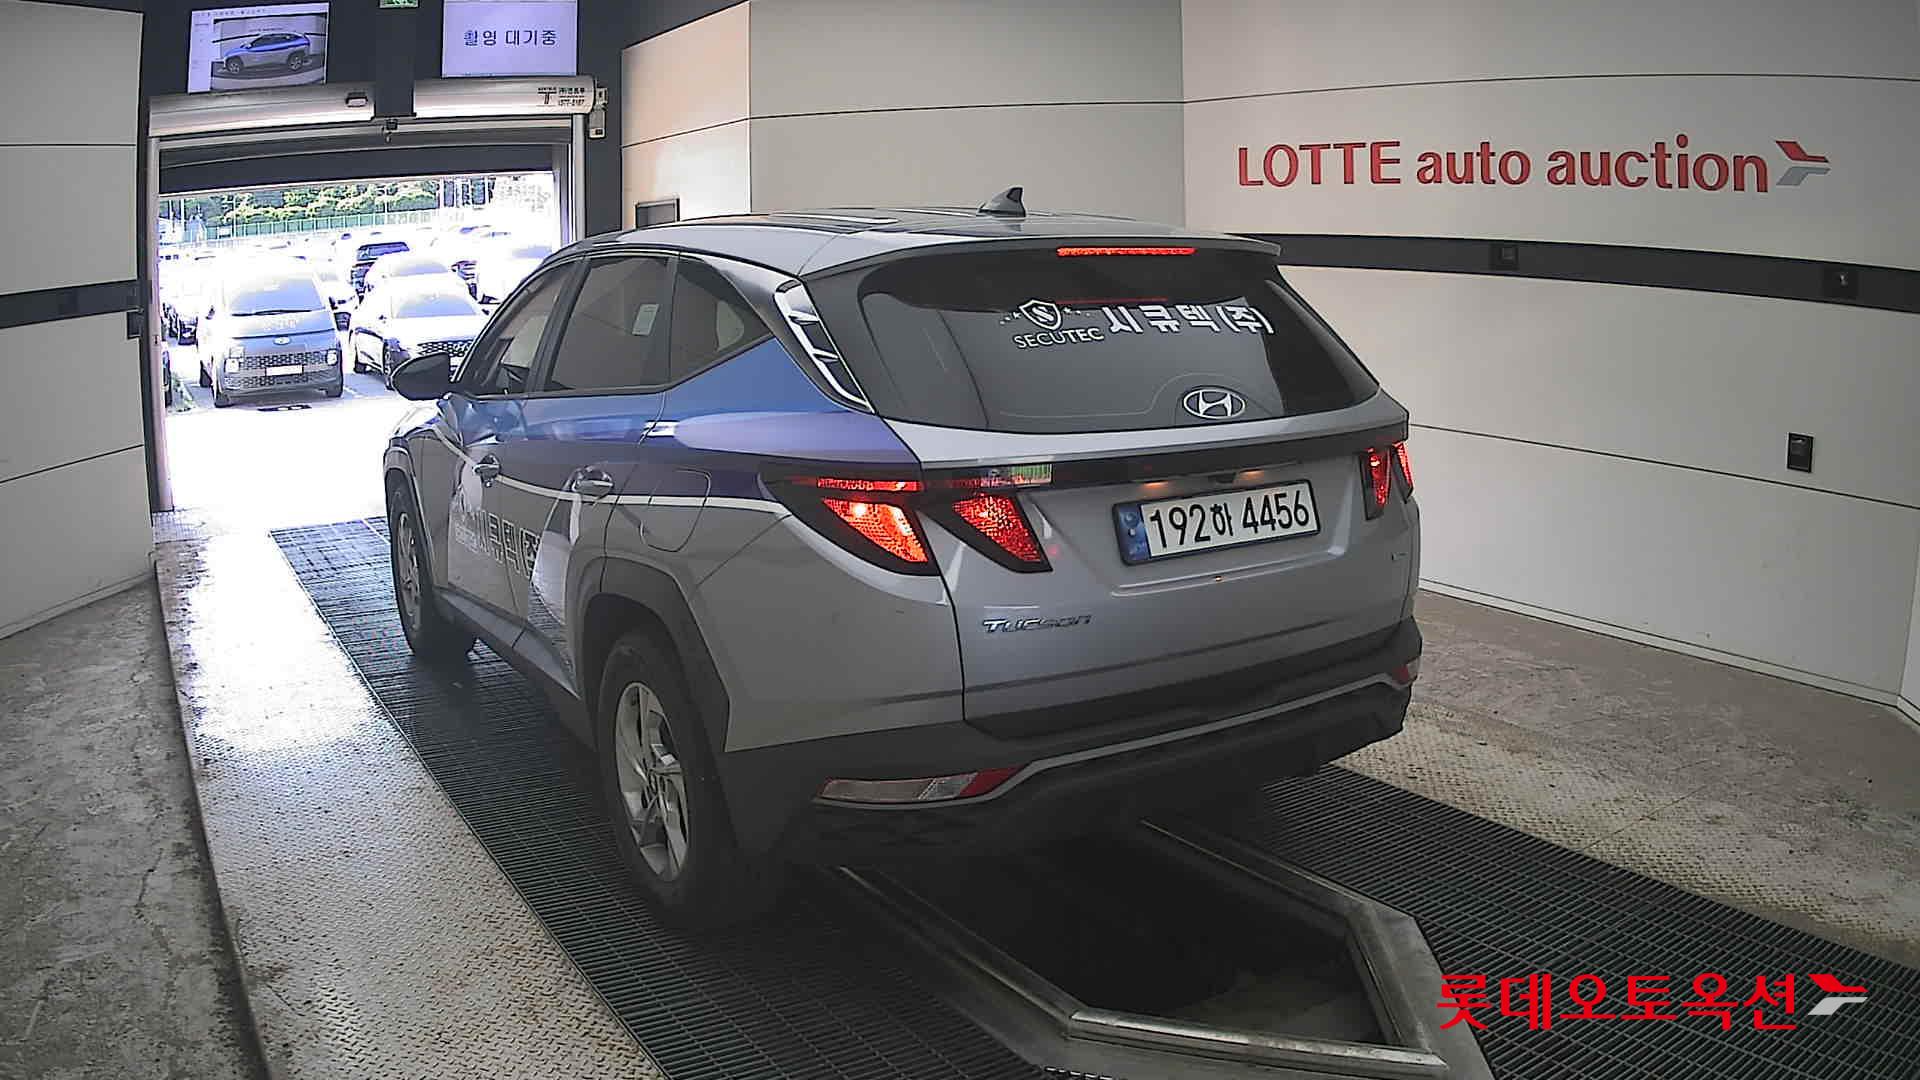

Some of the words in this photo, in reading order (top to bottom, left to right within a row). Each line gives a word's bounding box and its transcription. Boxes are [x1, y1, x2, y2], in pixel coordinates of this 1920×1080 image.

[505, 29, 559, 46] 대기중
[1238, 141, 1401, 188] LOTTE
[1416, 141, 1531, 186] auto
[1546, 133, 1769, 193] auction
[1013, 327, 1105, 349] SECUTEC
[1149, 502, 1235, 548] 192하
[1242, 490, 1310, 534] 4456
